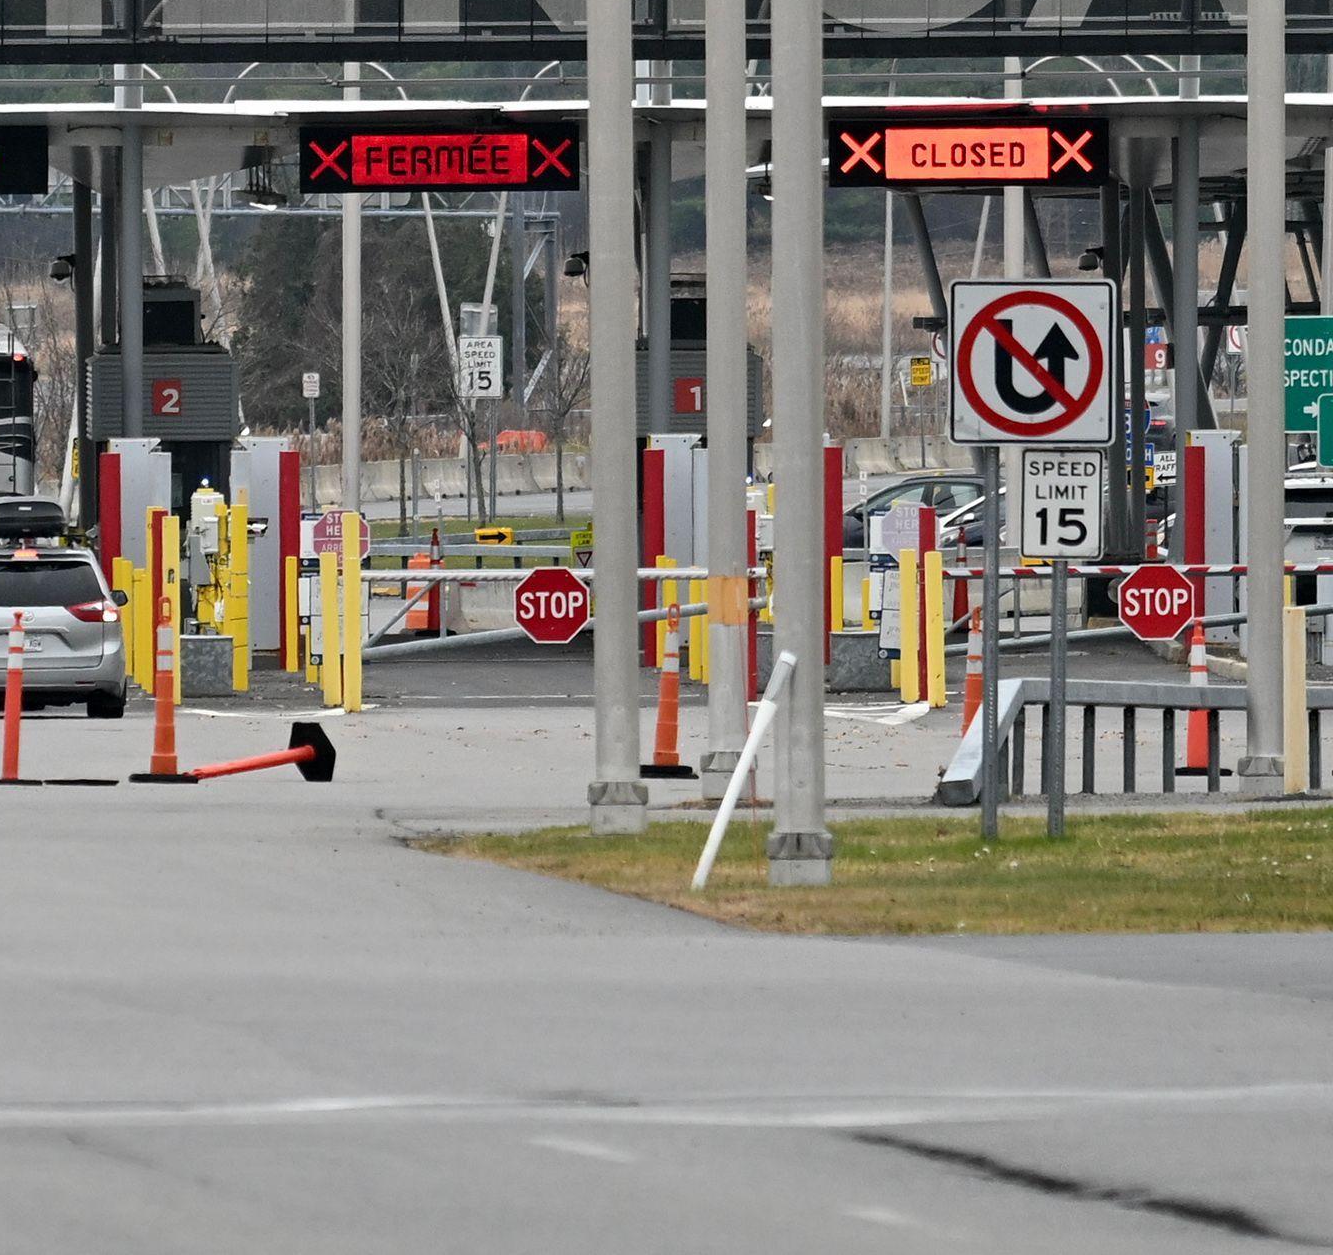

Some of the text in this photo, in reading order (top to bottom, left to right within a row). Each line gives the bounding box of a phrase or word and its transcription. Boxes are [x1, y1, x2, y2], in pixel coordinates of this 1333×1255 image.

[365, 136, 511, 175] FERMÉE
[910, 141, 1026, 168] CLOSED
[464, 350, 496, 359] SPEED
[466, 341, 494, 349] AREA
[1154, 349, 1166, 369] 9
[468, 370, 492, 391] 15
[160, 388, 180, 414] 2
[690, 385, 702, 410] 1
[1028, 461, 1097, 478] SPEED
[1160, 454, 1176, 463] ALL
[1035, 484, 1088, 501] LIMIT
[1035, 507, 1088, 546] 15
[519, 590, 586, 620] STOP
[1123, 587, 1190, 616] STOP
